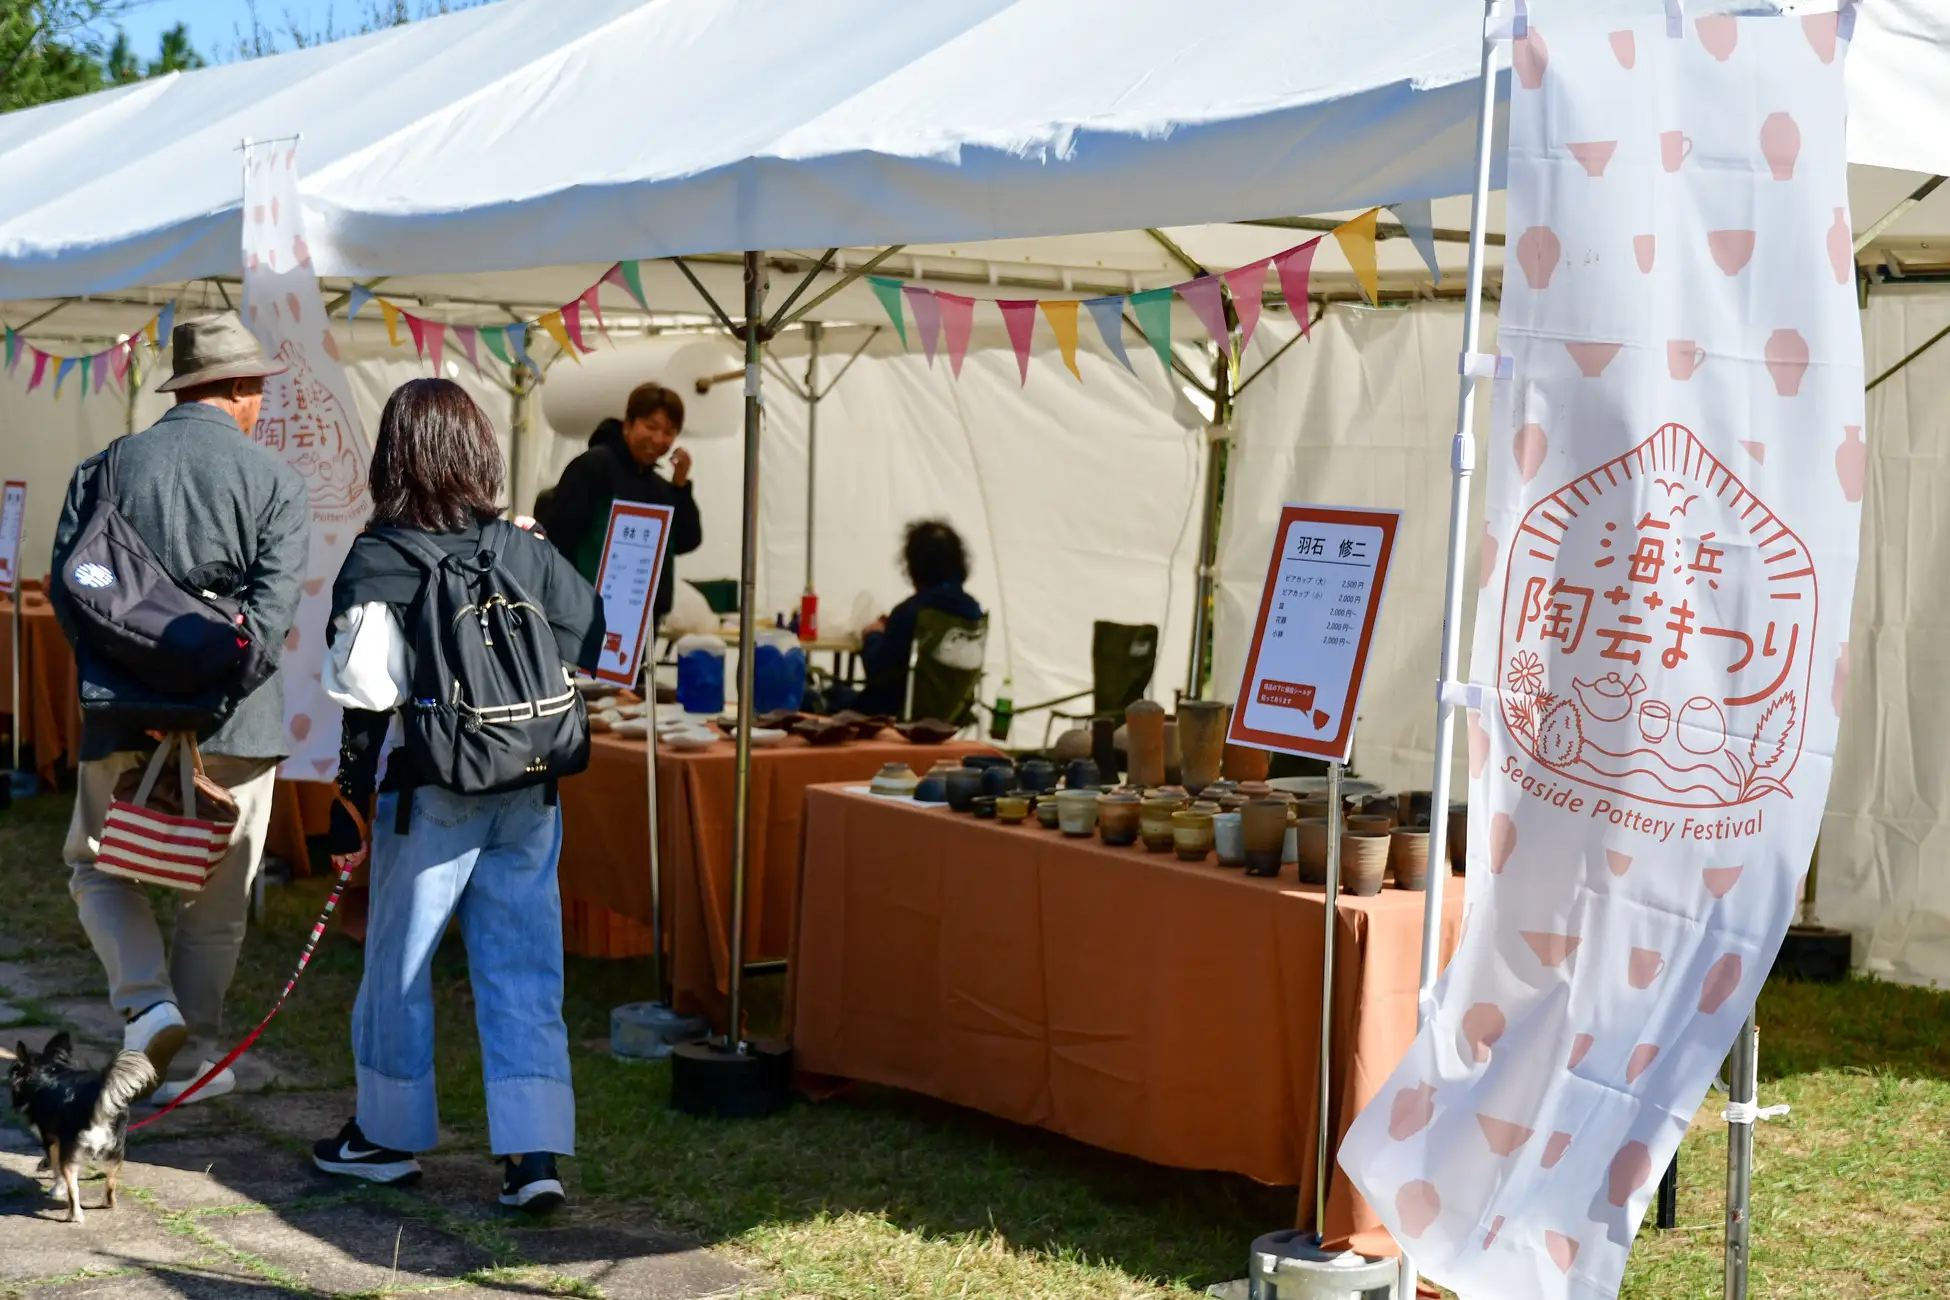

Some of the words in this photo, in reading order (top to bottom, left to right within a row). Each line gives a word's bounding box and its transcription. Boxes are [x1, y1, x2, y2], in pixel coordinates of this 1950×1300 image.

[1297, 536, 1326, 556] 羽石
[1338, 539, 1367, 558] 修二
[1594, 512, 1723, 589] 海浜
[1515, 576, 1799, 706] 陶芸まつり
[1500, 755, 1584, 812] Seaside
[1591, 799, 1675, 842] Pottery
[1681, 809, 1763, 841] Festival
